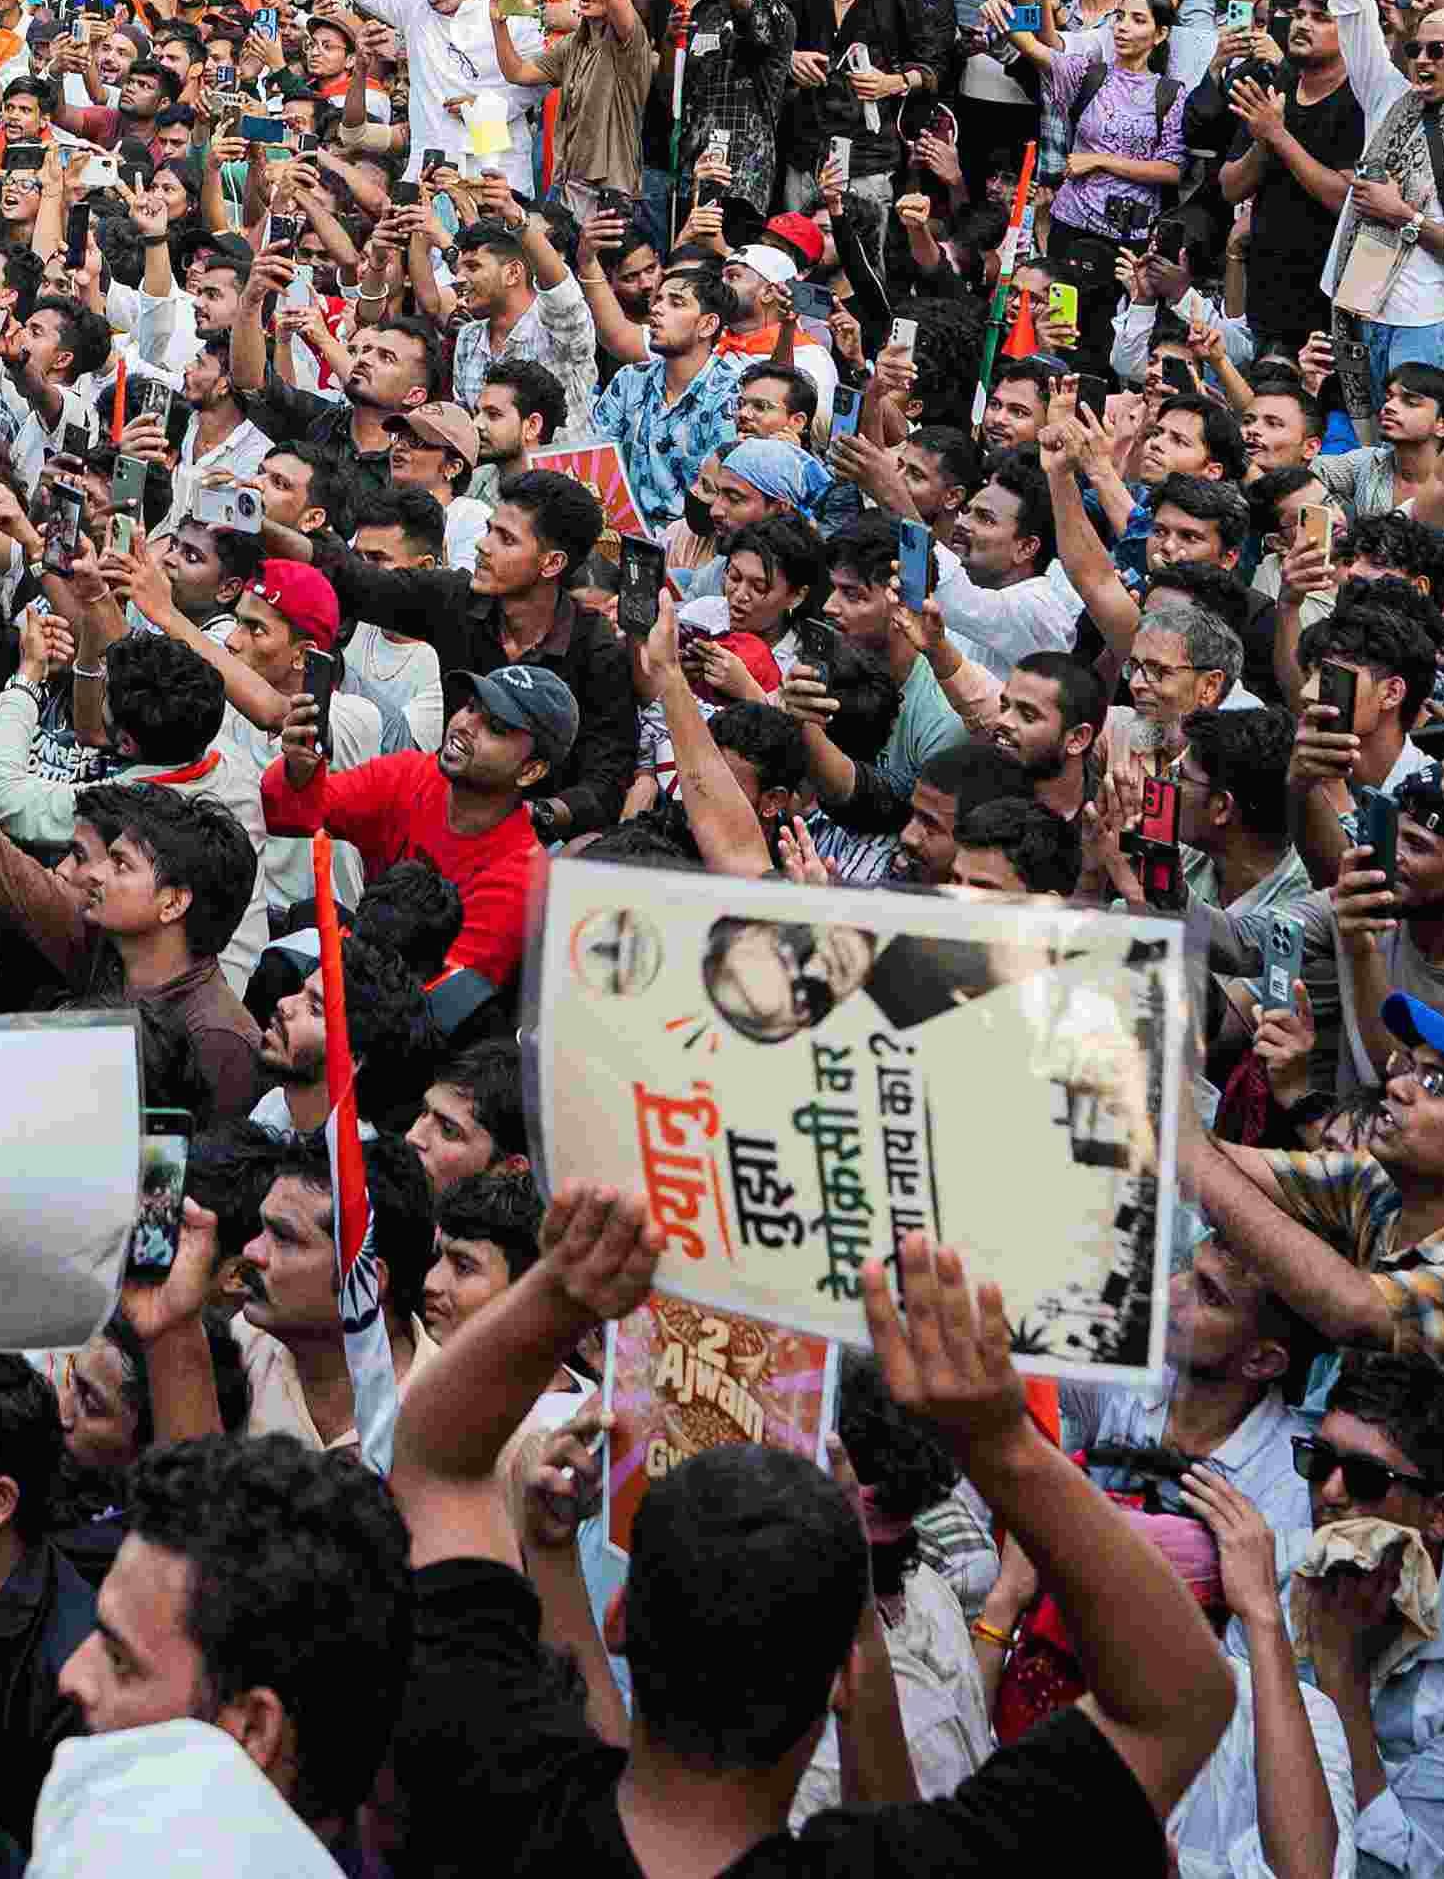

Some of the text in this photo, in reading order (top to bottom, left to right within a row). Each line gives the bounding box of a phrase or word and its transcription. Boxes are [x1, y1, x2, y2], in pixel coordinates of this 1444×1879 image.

[812, 1039, 856, 1092] वर
[726, 1129, 805, 1247] तुझा
[882, 1126, 920, 1196] नाय
[697, 1318, 731, 1370] 2
[655, 1342, 765, 1445] Ajwain
